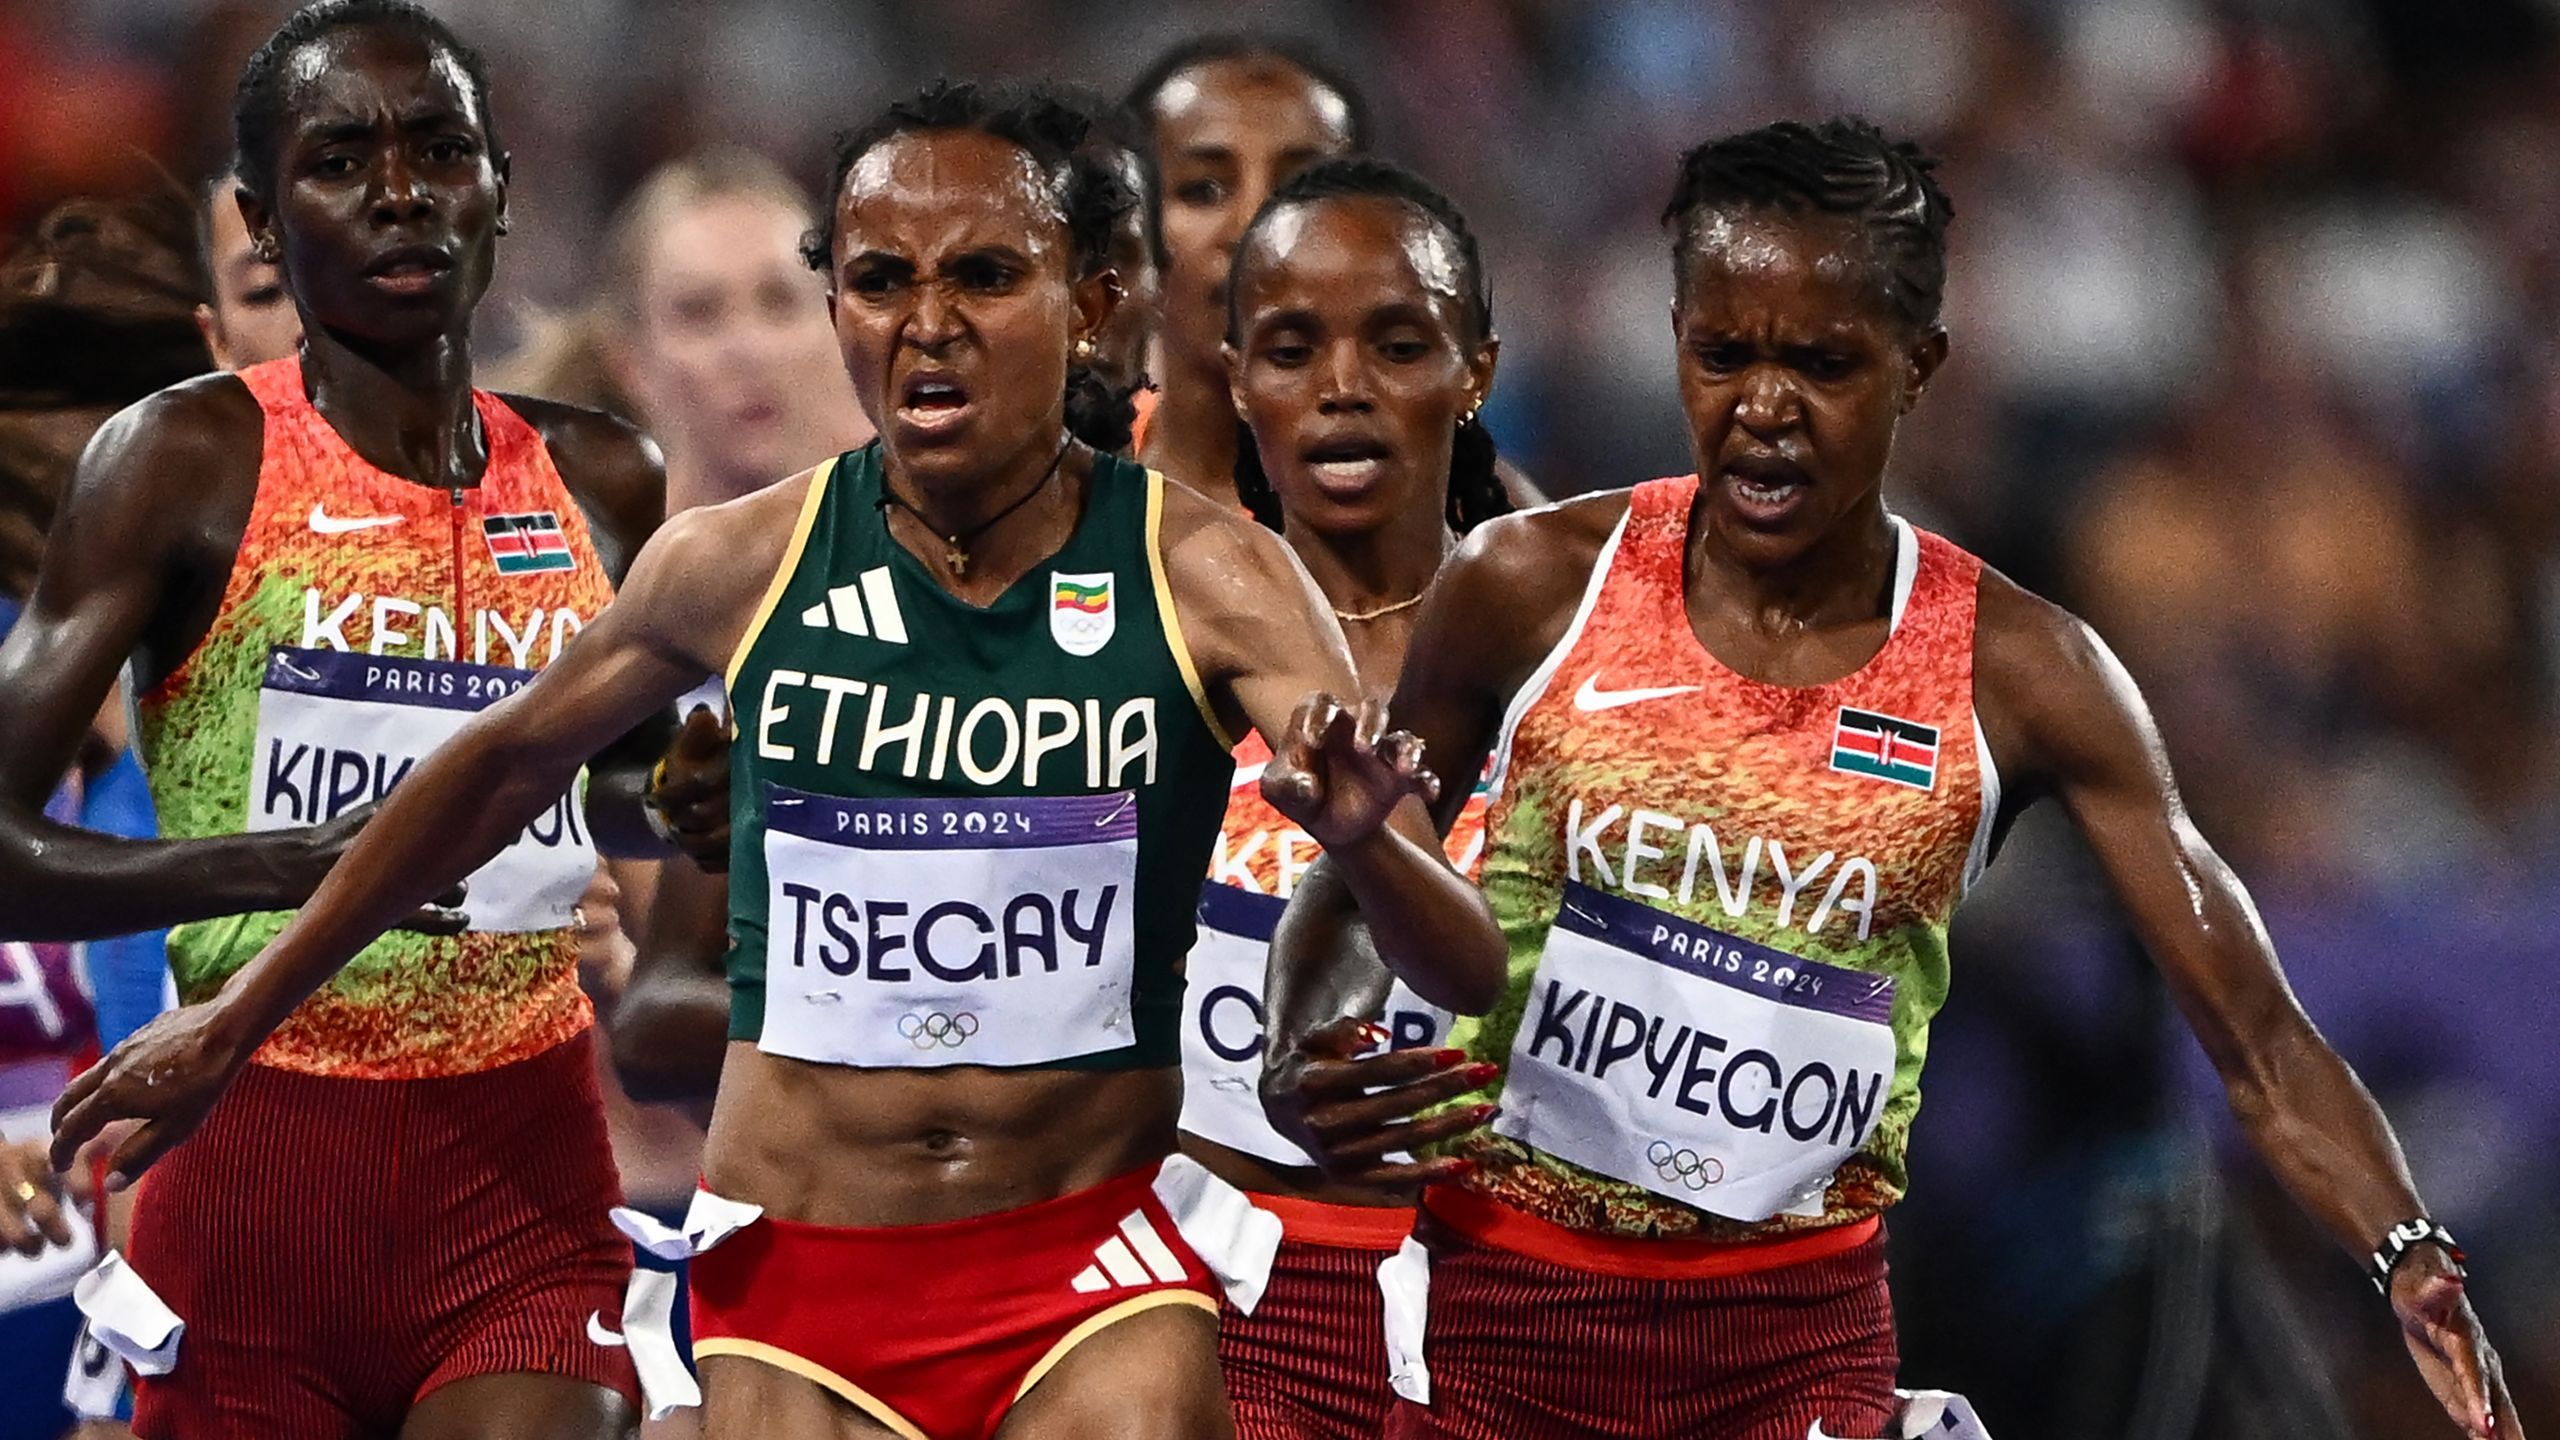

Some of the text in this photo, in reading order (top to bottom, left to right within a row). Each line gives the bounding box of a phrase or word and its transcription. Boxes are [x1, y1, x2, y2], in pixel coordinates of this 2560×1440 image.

[301, 588, 582, 670] KENYA
[366, 667, 523, 699] PARIS 202
[758, 670, 1158, 788] ETHIOPIA
[837, 813, 1031, 835] PARIS 2024
[1567, 799, 1876, 941] KENYA
[783, 882, 1118, 982] TSEGAY
[1652, 924, 1822, 996] PARIS 2024
[1529, 980, 1882, 1147] KIPYEGON
